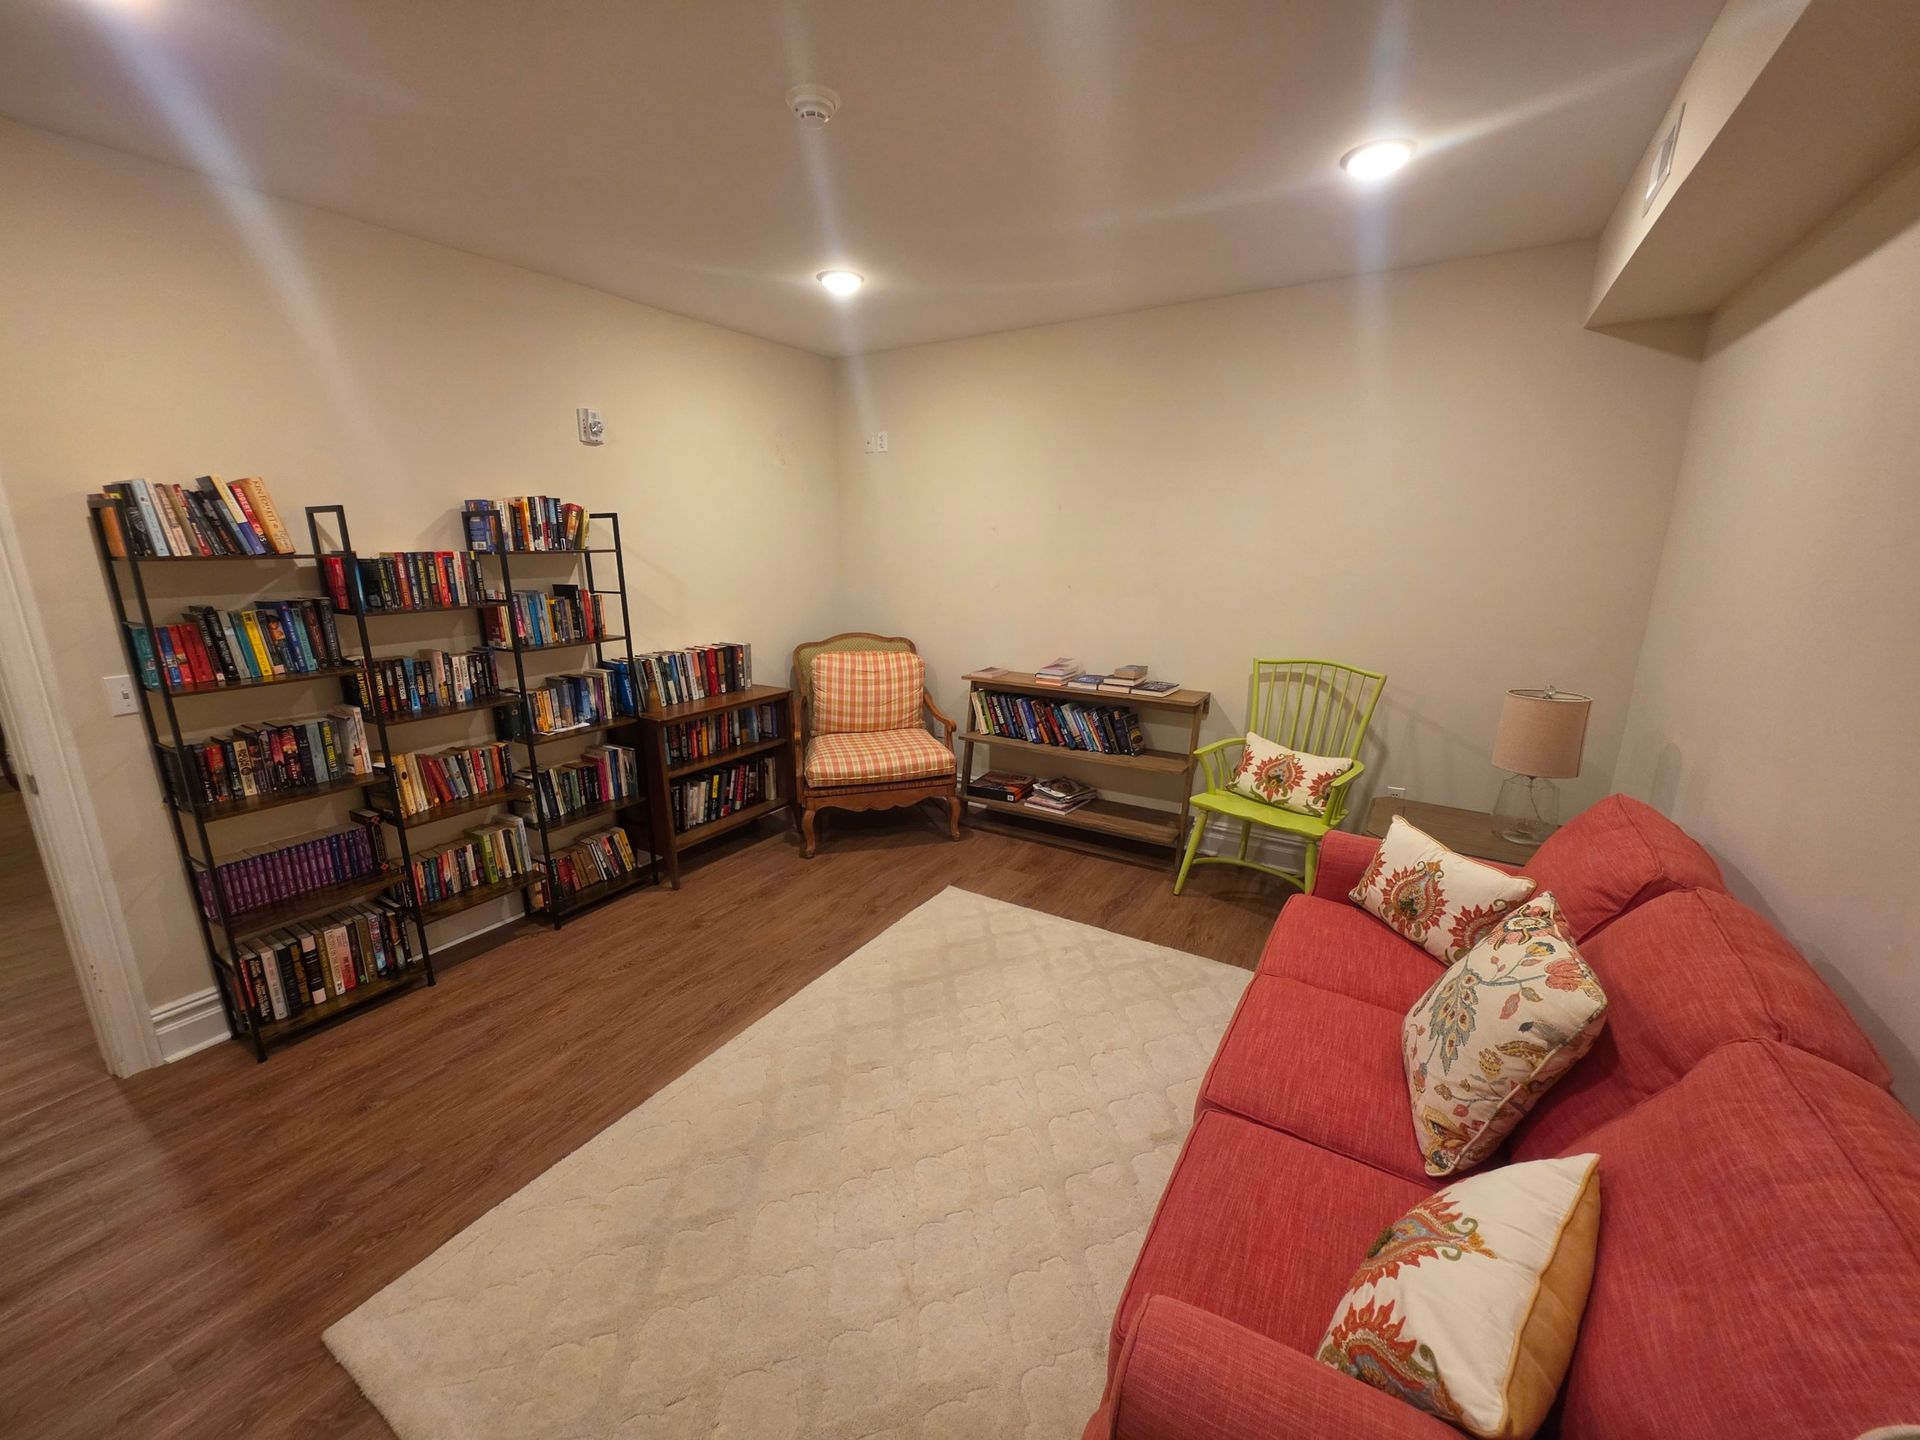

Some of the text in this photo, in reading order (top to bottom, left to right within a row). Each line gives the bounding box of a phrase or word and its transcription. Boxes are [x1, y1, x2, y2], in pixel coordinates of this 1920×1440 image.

[234, 487, 252, 514] ROBERT
[252, 478, 277, 523] KEN FOLLETT
